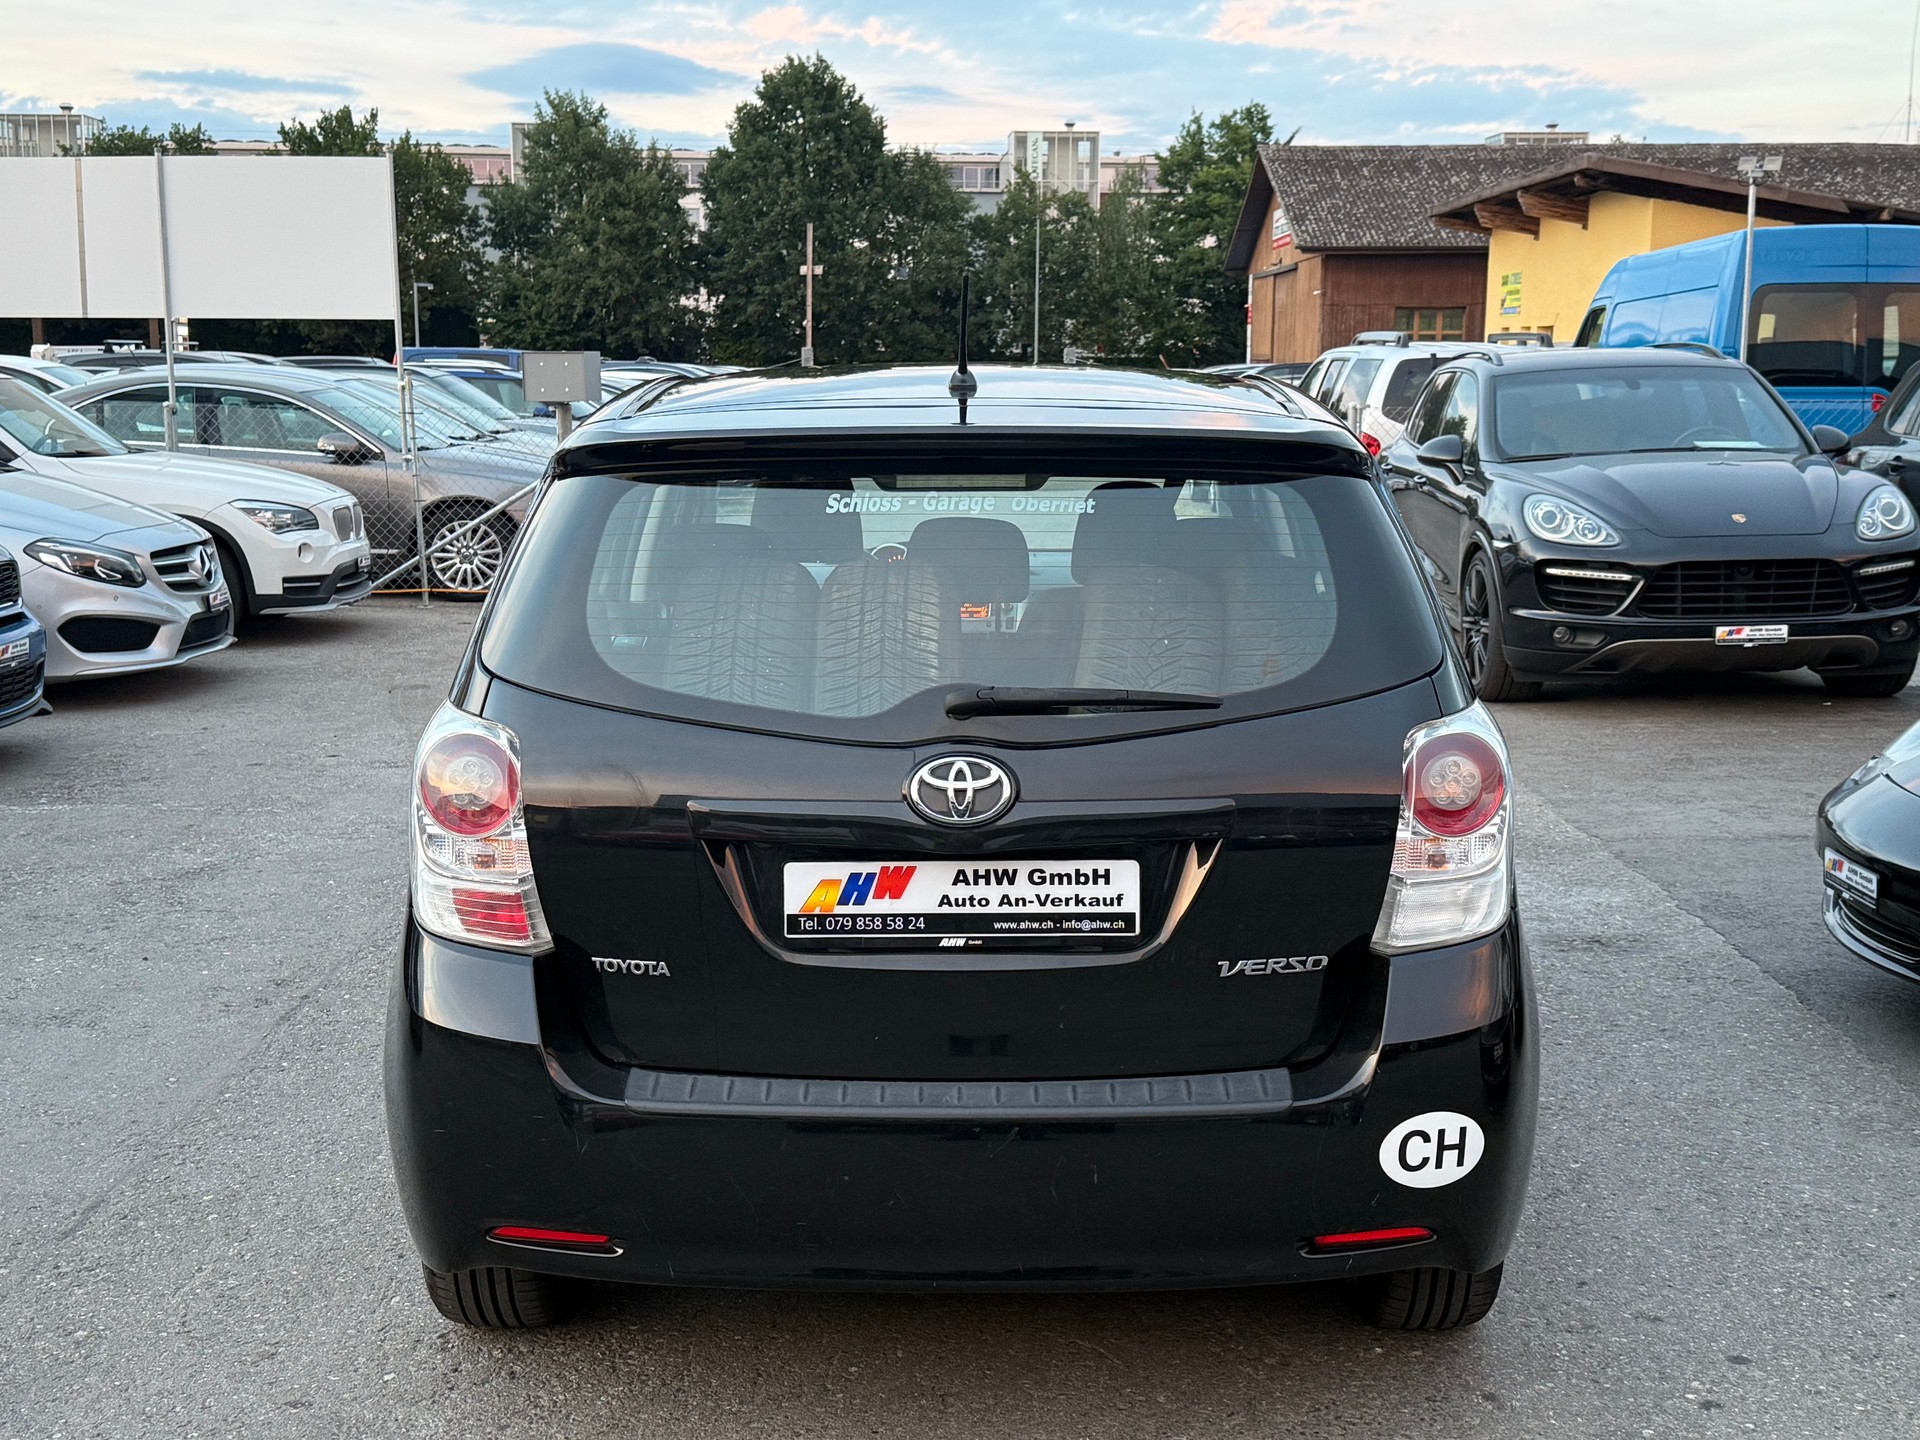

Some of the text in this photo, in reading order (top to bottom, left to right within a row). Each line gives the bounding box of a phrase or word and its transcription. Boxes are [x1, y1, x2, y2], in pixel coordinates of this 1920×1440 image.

[825, 492, 902, 514] Schloss
[922, 491, 995, 515] Garage
[1011, 497, 1096, 514] Oberriet
[951, 868, 1111, 887] AHW GmbH
[799, 866, 917, 913] AHW
[937, 892, 1125, 908] Auto An-Verkauf
[798, 916, 925, 931] Tel. 079 858 58 24
[993, 920, 1054, 930] www.ahw.ch
[1062, 919, 1126, 931] info@ahw.ch
[939, 938, 967, 947] AHW
[591, 957, 671, 977] TOYOTA
[1218, 955, 1329, 978] VERSO
[1398, 1126, 1467, 1172] CH
